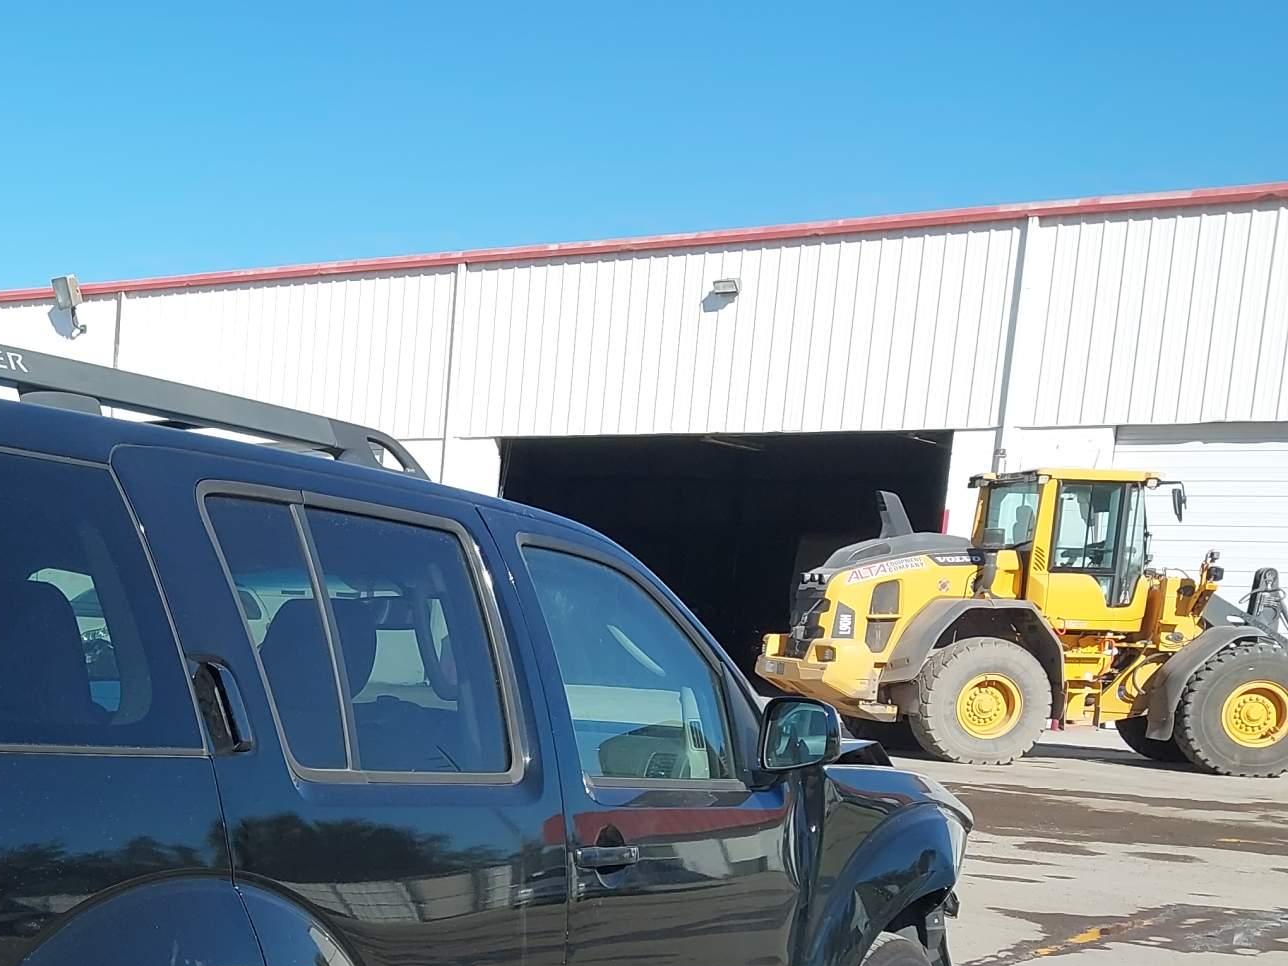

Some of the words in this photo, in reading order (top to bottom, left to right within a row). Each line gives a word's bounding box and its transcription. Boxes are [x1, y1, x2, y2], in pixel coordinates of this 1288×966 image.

[935, 555, 981, 563] VOLVO
[888, 562, 924, 573] COMPANY
[848, 564, 888, 583] ALTA
